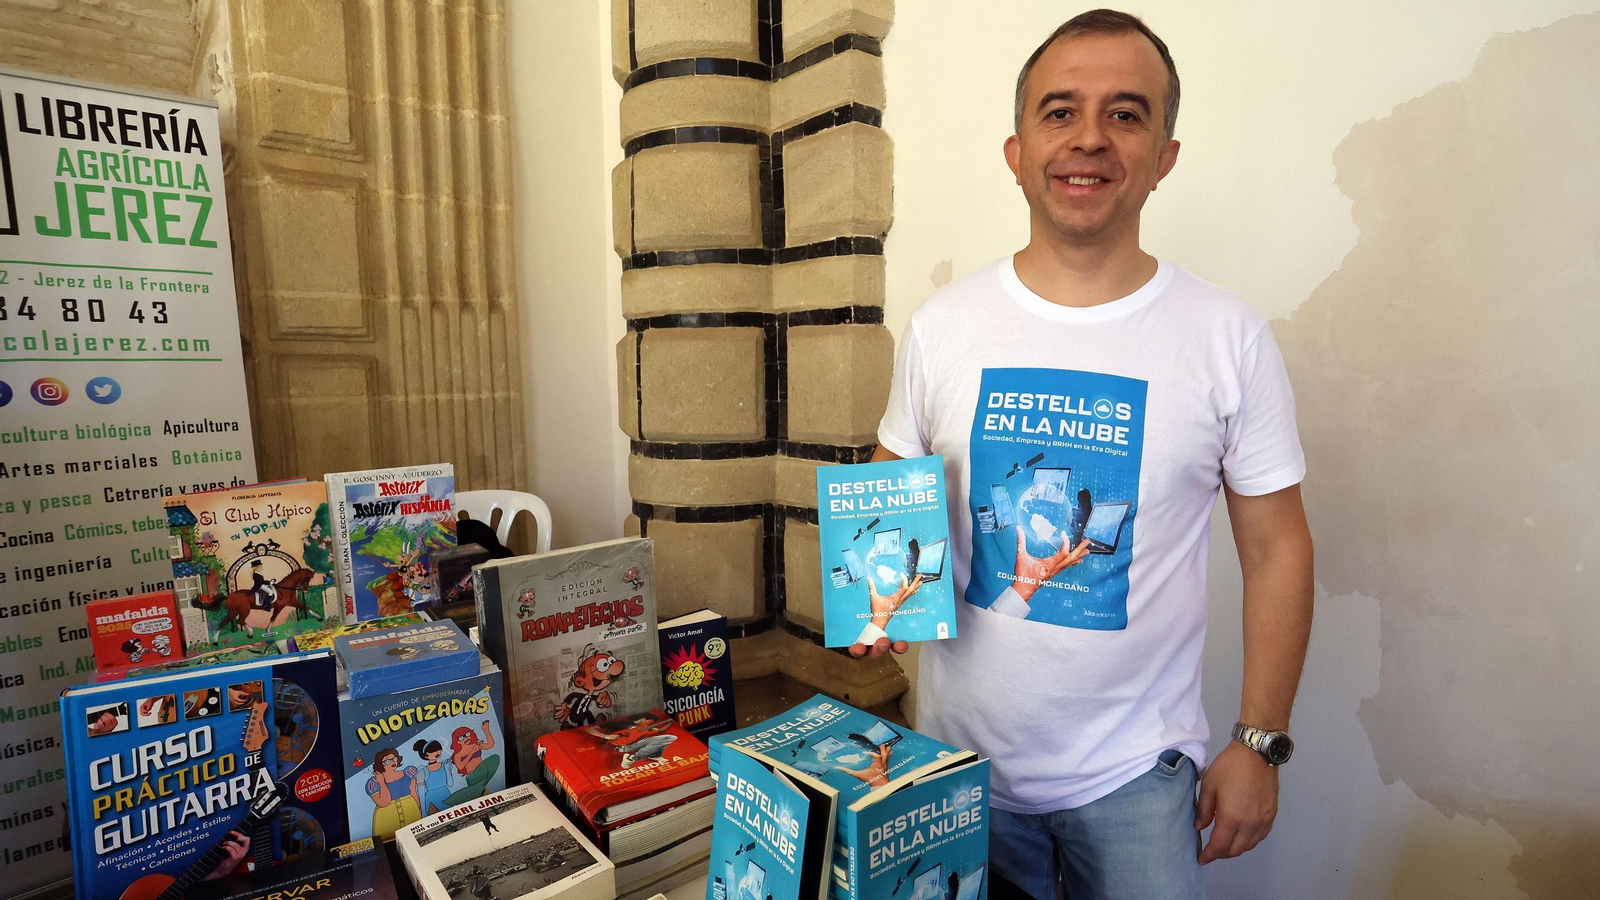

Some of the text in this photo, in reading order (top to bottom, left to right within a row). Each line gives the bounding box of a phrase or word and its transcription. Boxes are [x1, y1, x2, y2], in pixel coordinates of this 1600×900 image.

[15, 92, 208, 156] LIBRERÍA
[56, 147, 210, 192] AGRÍCOLA
[34, 181, 218, 248] JEREZ
[34, 271, 85, 288] Jerez
[93, 274, 112, 289] de
[119, 276, 133, 290] la
[140, 277, 209, 293] Frontera
[61, 298, 105, 323] 80
[129, 300, 168, 324] 43
[987, 392, 1132, 420] DESTELLOS
[1, 418, 239, 444] cultura biológica Apicultura
[984, 414, 1130, 445] EN LA NUBE
[982, 434, 1015, 443] Sociedad,
[1016, 437, 1046, 447] Empresa
[1104, 446, 1128, 457] Digital
[0, 450, 242, 479] Artes marciales Botánica
[353, 473, 396, 483] GOSCINNY
[411, 469, 442, 477] UDERZO
[22, 500, 32, 514] y
[40, 494, 92, 513] pesca
[104, 484, 173, 503] Cetrería
[192, 482, 225, 494] aves
[230, 476, 246, 491] de
[828, 473, 937, 496] DESTELLOS
[830, 490, 937, 512] EN LA NUBE
[857, 511, 879, 519] Empresa
[922, 504, 939, 512] Digital
[200, 503, 312, 526] El Club Hípico
[64, 522, 128, 541] Cómics,
[242, 518, 288, 538] POP-UP
[15, 556, 113, 583] ingeniería
[997, 571, 1090, 593] EDUARDO MOHEDANO
[557, 586, 608, 602] INTEGRAL
[561, 578, 603, 592] EDICIÓN
[95, 606, 169, 625] mafalda
[521, 595, 644, 642] ROMPETECHOS
[889, 607, 926, 616] MOHEDANO
[97, 621, 133, 634] 2025
[687, 628, 703, 637] Amat
[39, 661, 70, 681] Ind.
[372, 696, 420, 718] UN CUENTO DE
[678, 704, 711, 727] PUNK
[355, 696, 490, 746] IDIOTIZADAS
[744, 740, 773, 751] EN
[772, 732, 800, 744] LA
[797, 707, 845, 733] NUBE
[0, 736, 61, 760] úsica,
[89, 725, 214, 791] CURSO
[600, 757, 670, 782] APRENDE
[672, 755, 684, 763] A
[601, 769, 657, 788] TOCAR
[659, 764, 678, 773] EL
[852, 755, 916, 791] EDUARDO MOHEDANO
[93, 751, 262, 820] PRÁCTICO DE
[93, 766, 277, 856] GUITARRA
[438, 795, 505, 823] PEARL JAM
[869, 785, 983, 848] DESTELLOS
[426, 821, 440, 829] YOU
[724, 794, 744, 818] EN
[745, 806, 760, 832] LA
[763, 820, 797, 863] NUBE
[870, 806, 982, 870] EN LA NUBE
[97, 813, 231, 869] Afinación Acordes Estilos
[115, 831, 210, 872] Técnicas Ejercicios
[897, 850, 920, 865] Empresa
[955, 830, 964, 839] Era
[964, 824, 982, 836] Digital
[149, 846, 196, 869] Canciones
